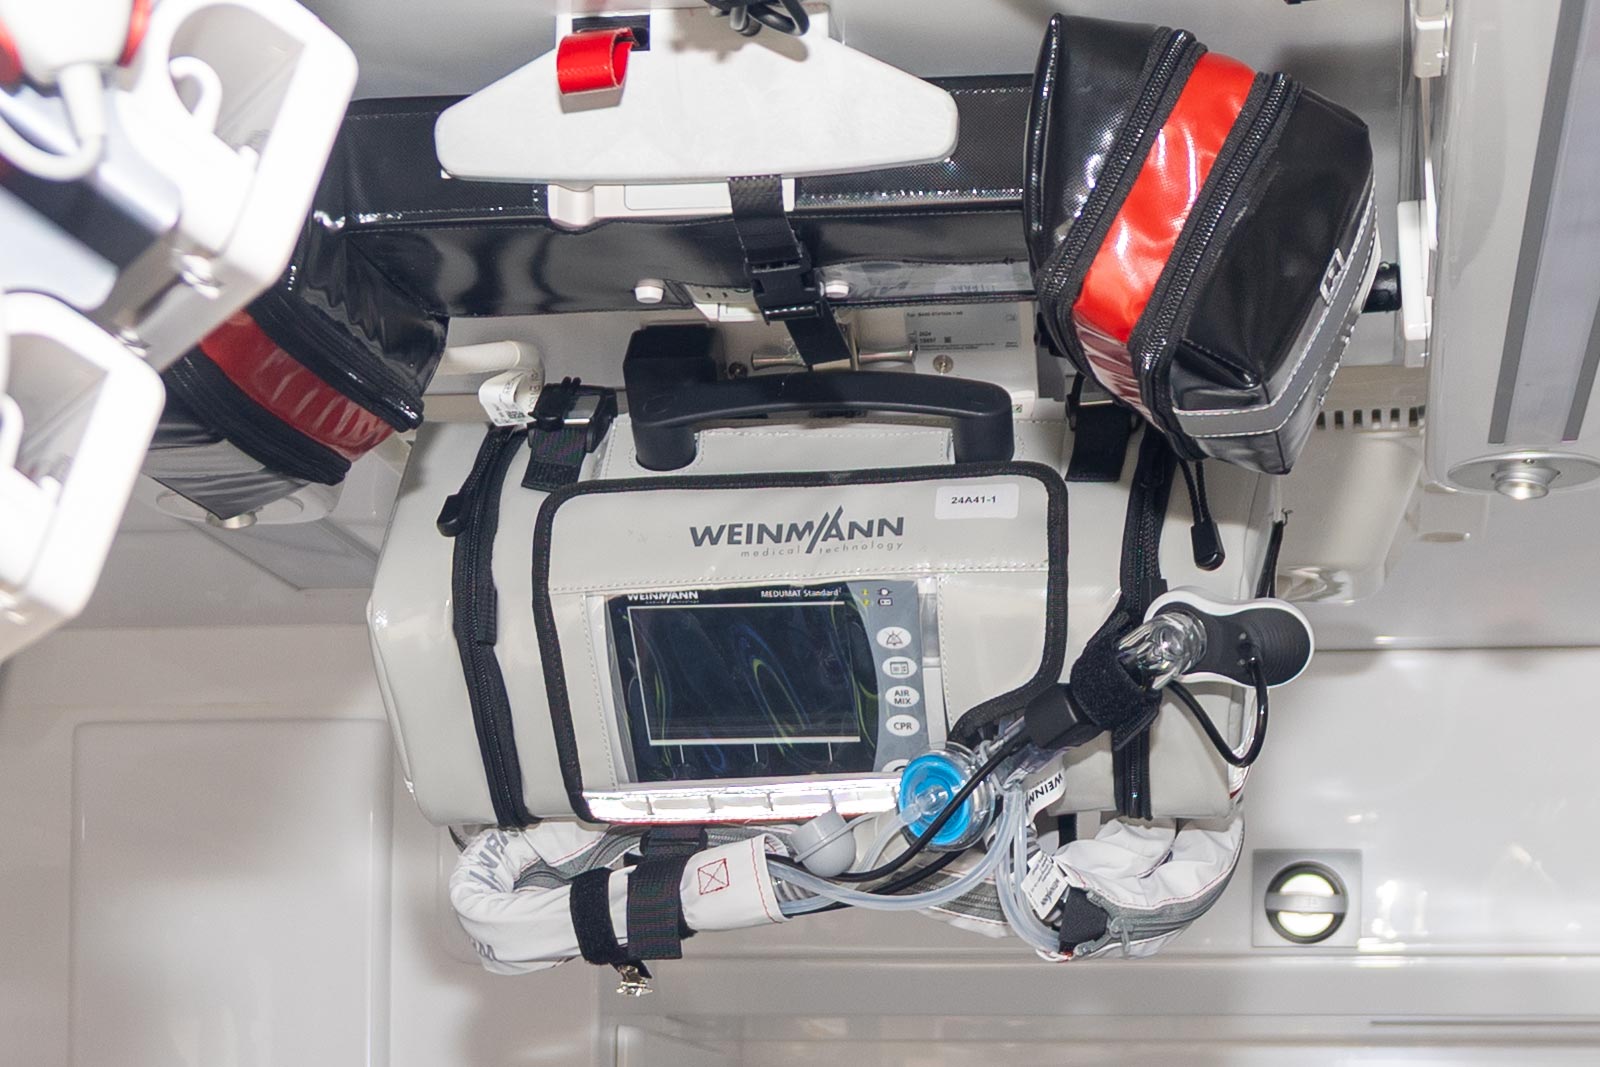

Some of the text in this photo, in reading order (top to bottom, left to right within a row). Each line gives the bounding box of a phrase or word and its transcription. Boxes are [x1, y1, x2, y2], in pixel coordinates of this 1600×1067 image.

[951, 495, 997, 505] 24A41-1
[741, 541, 904, 557] medical technology
[761, 589, 801, 598] MEDUMAT
[893, 722, 912, 730] CPR
